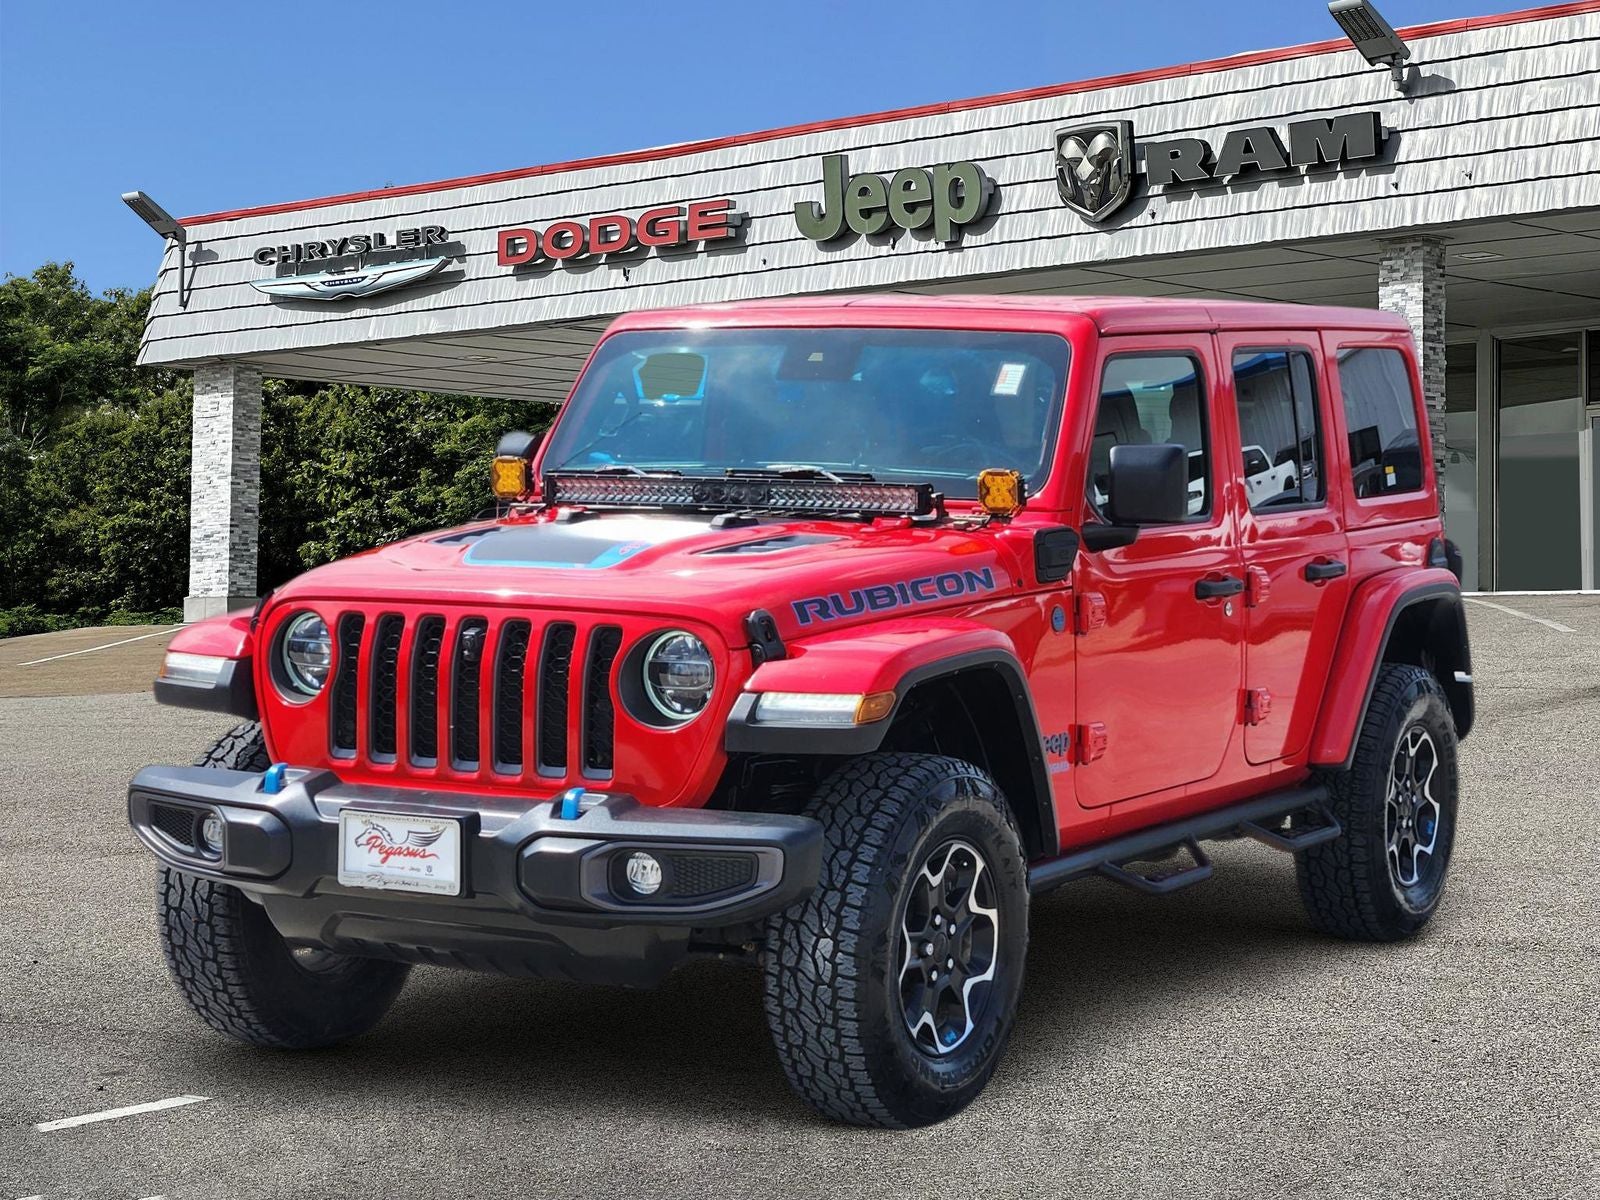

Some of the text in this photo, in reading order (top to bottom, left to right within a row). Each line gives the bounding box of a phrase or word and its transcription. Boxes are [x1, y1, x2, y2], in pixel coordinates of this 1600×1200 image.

[1145, 111, 1380, 186] RAM
[794, 154, 987, 242] Jeep
[253, 225, 447, 266] CHRYSLER
[498, 200, 736, 266] DODGE
[324, 277, 363, 287] CHRYSLER
[791, 566, 996, 626] RUBICON
[1042, 732, 1070, 757] eep
[366, 835, 440, 864] Pegasus
